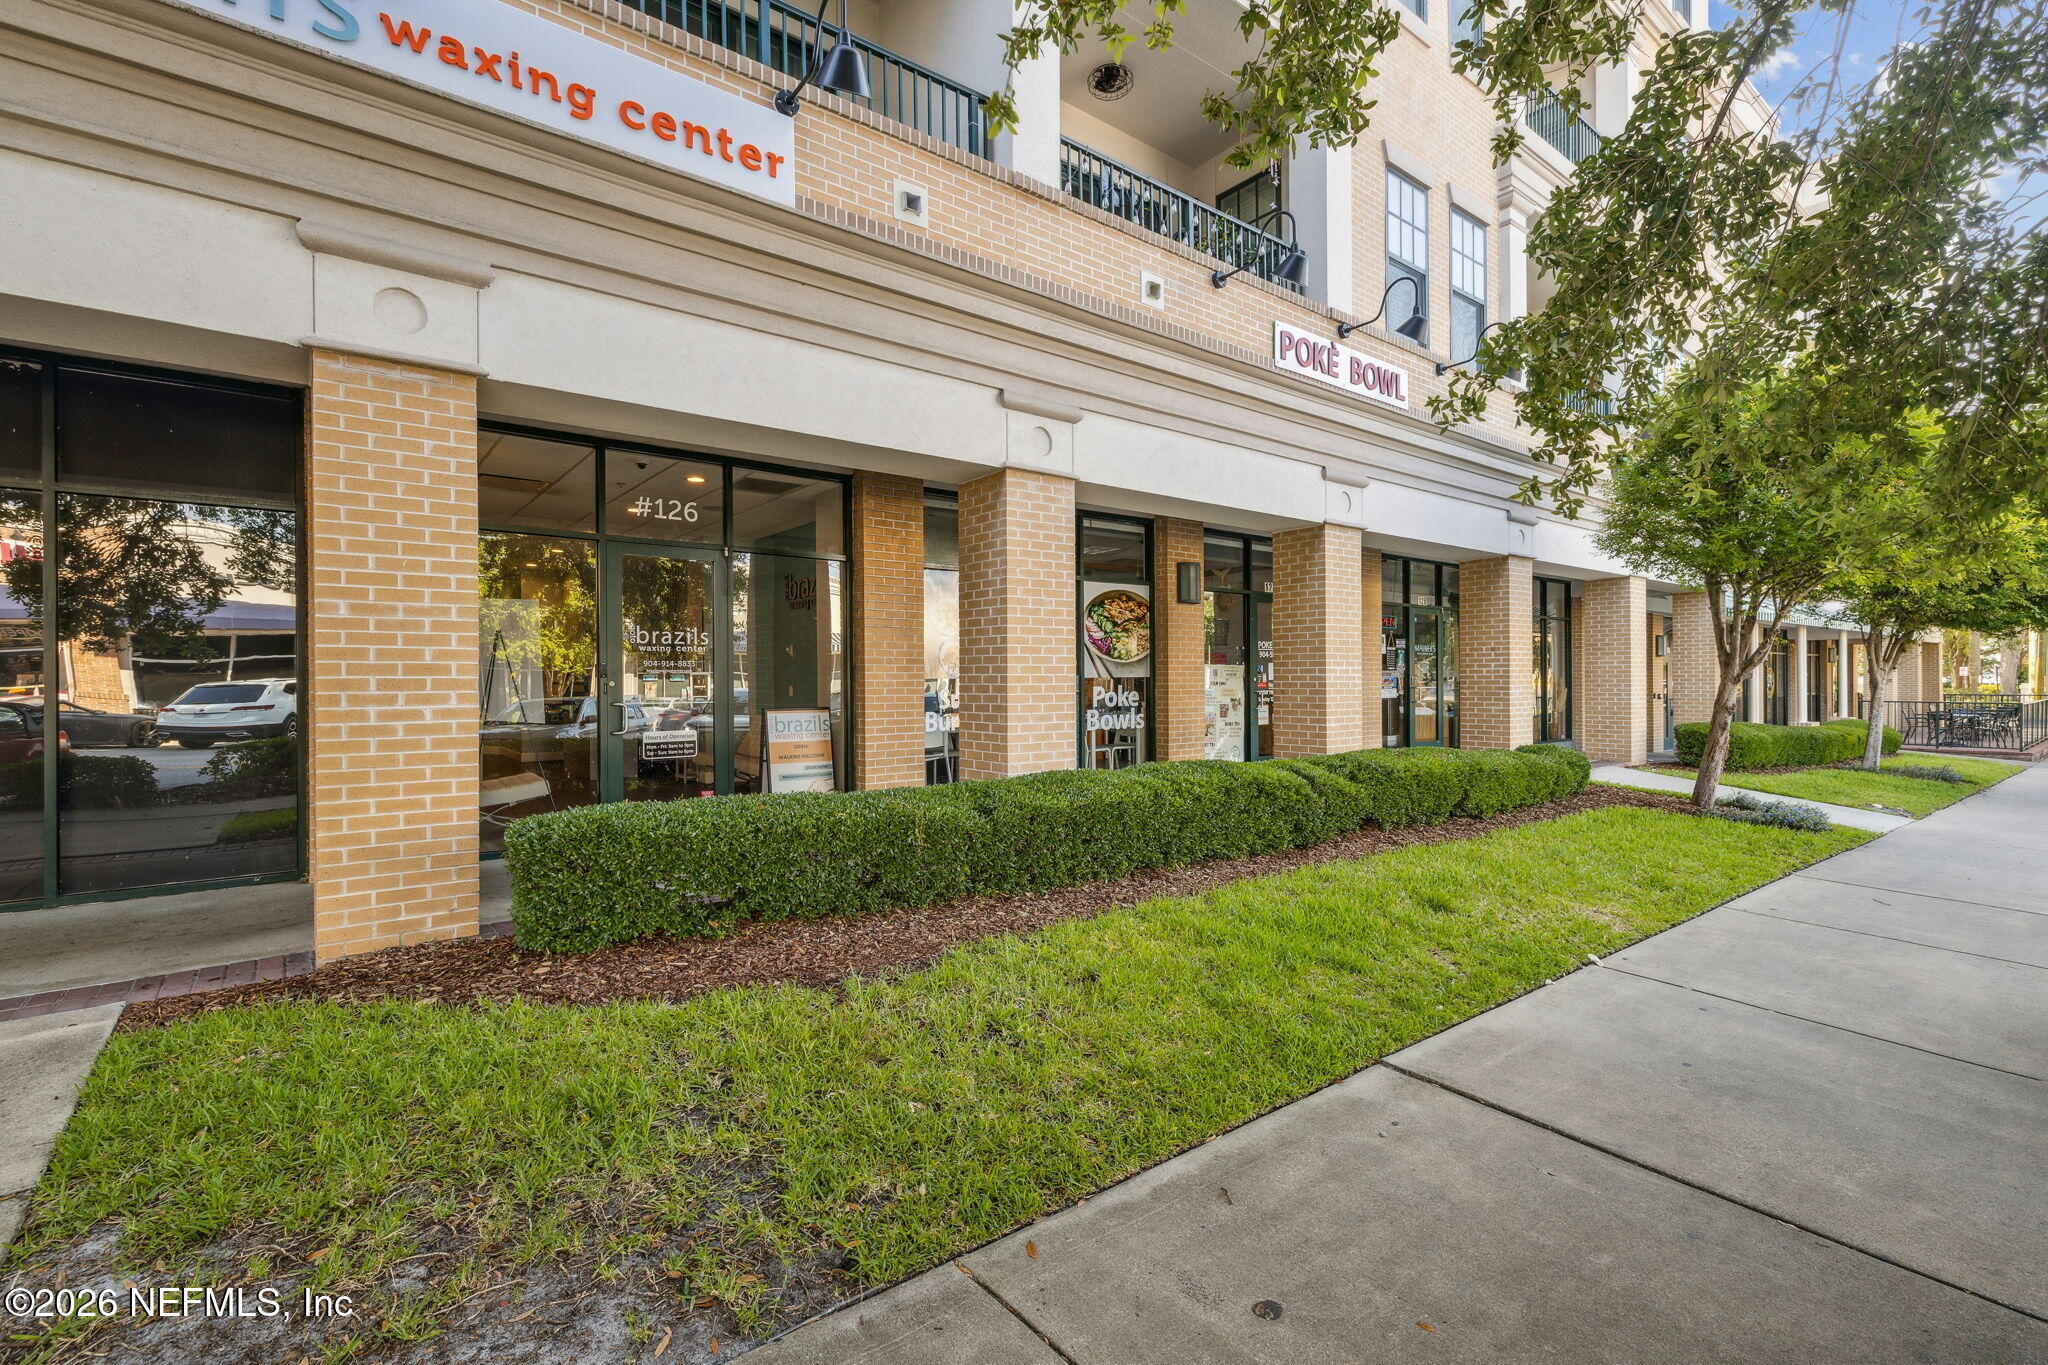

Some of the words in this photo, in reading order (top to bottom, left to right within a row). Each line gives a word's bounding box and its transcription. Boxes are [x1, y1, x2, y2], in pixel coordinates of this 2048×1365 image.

[380, 12, 596, 120] waxing
[619, 100, 784, 178] center
[1350, 356, 1406, 401] BOWL
[635, 496, 699, 522] #126
[636, 625, 709, 645] brazils
[639, 645, 671, 653] waxing
[1093, 685, 1139, 707] Poke
[775, 715, 830, 732] brazils
[1087, 708, 1144, 730] Bowls
